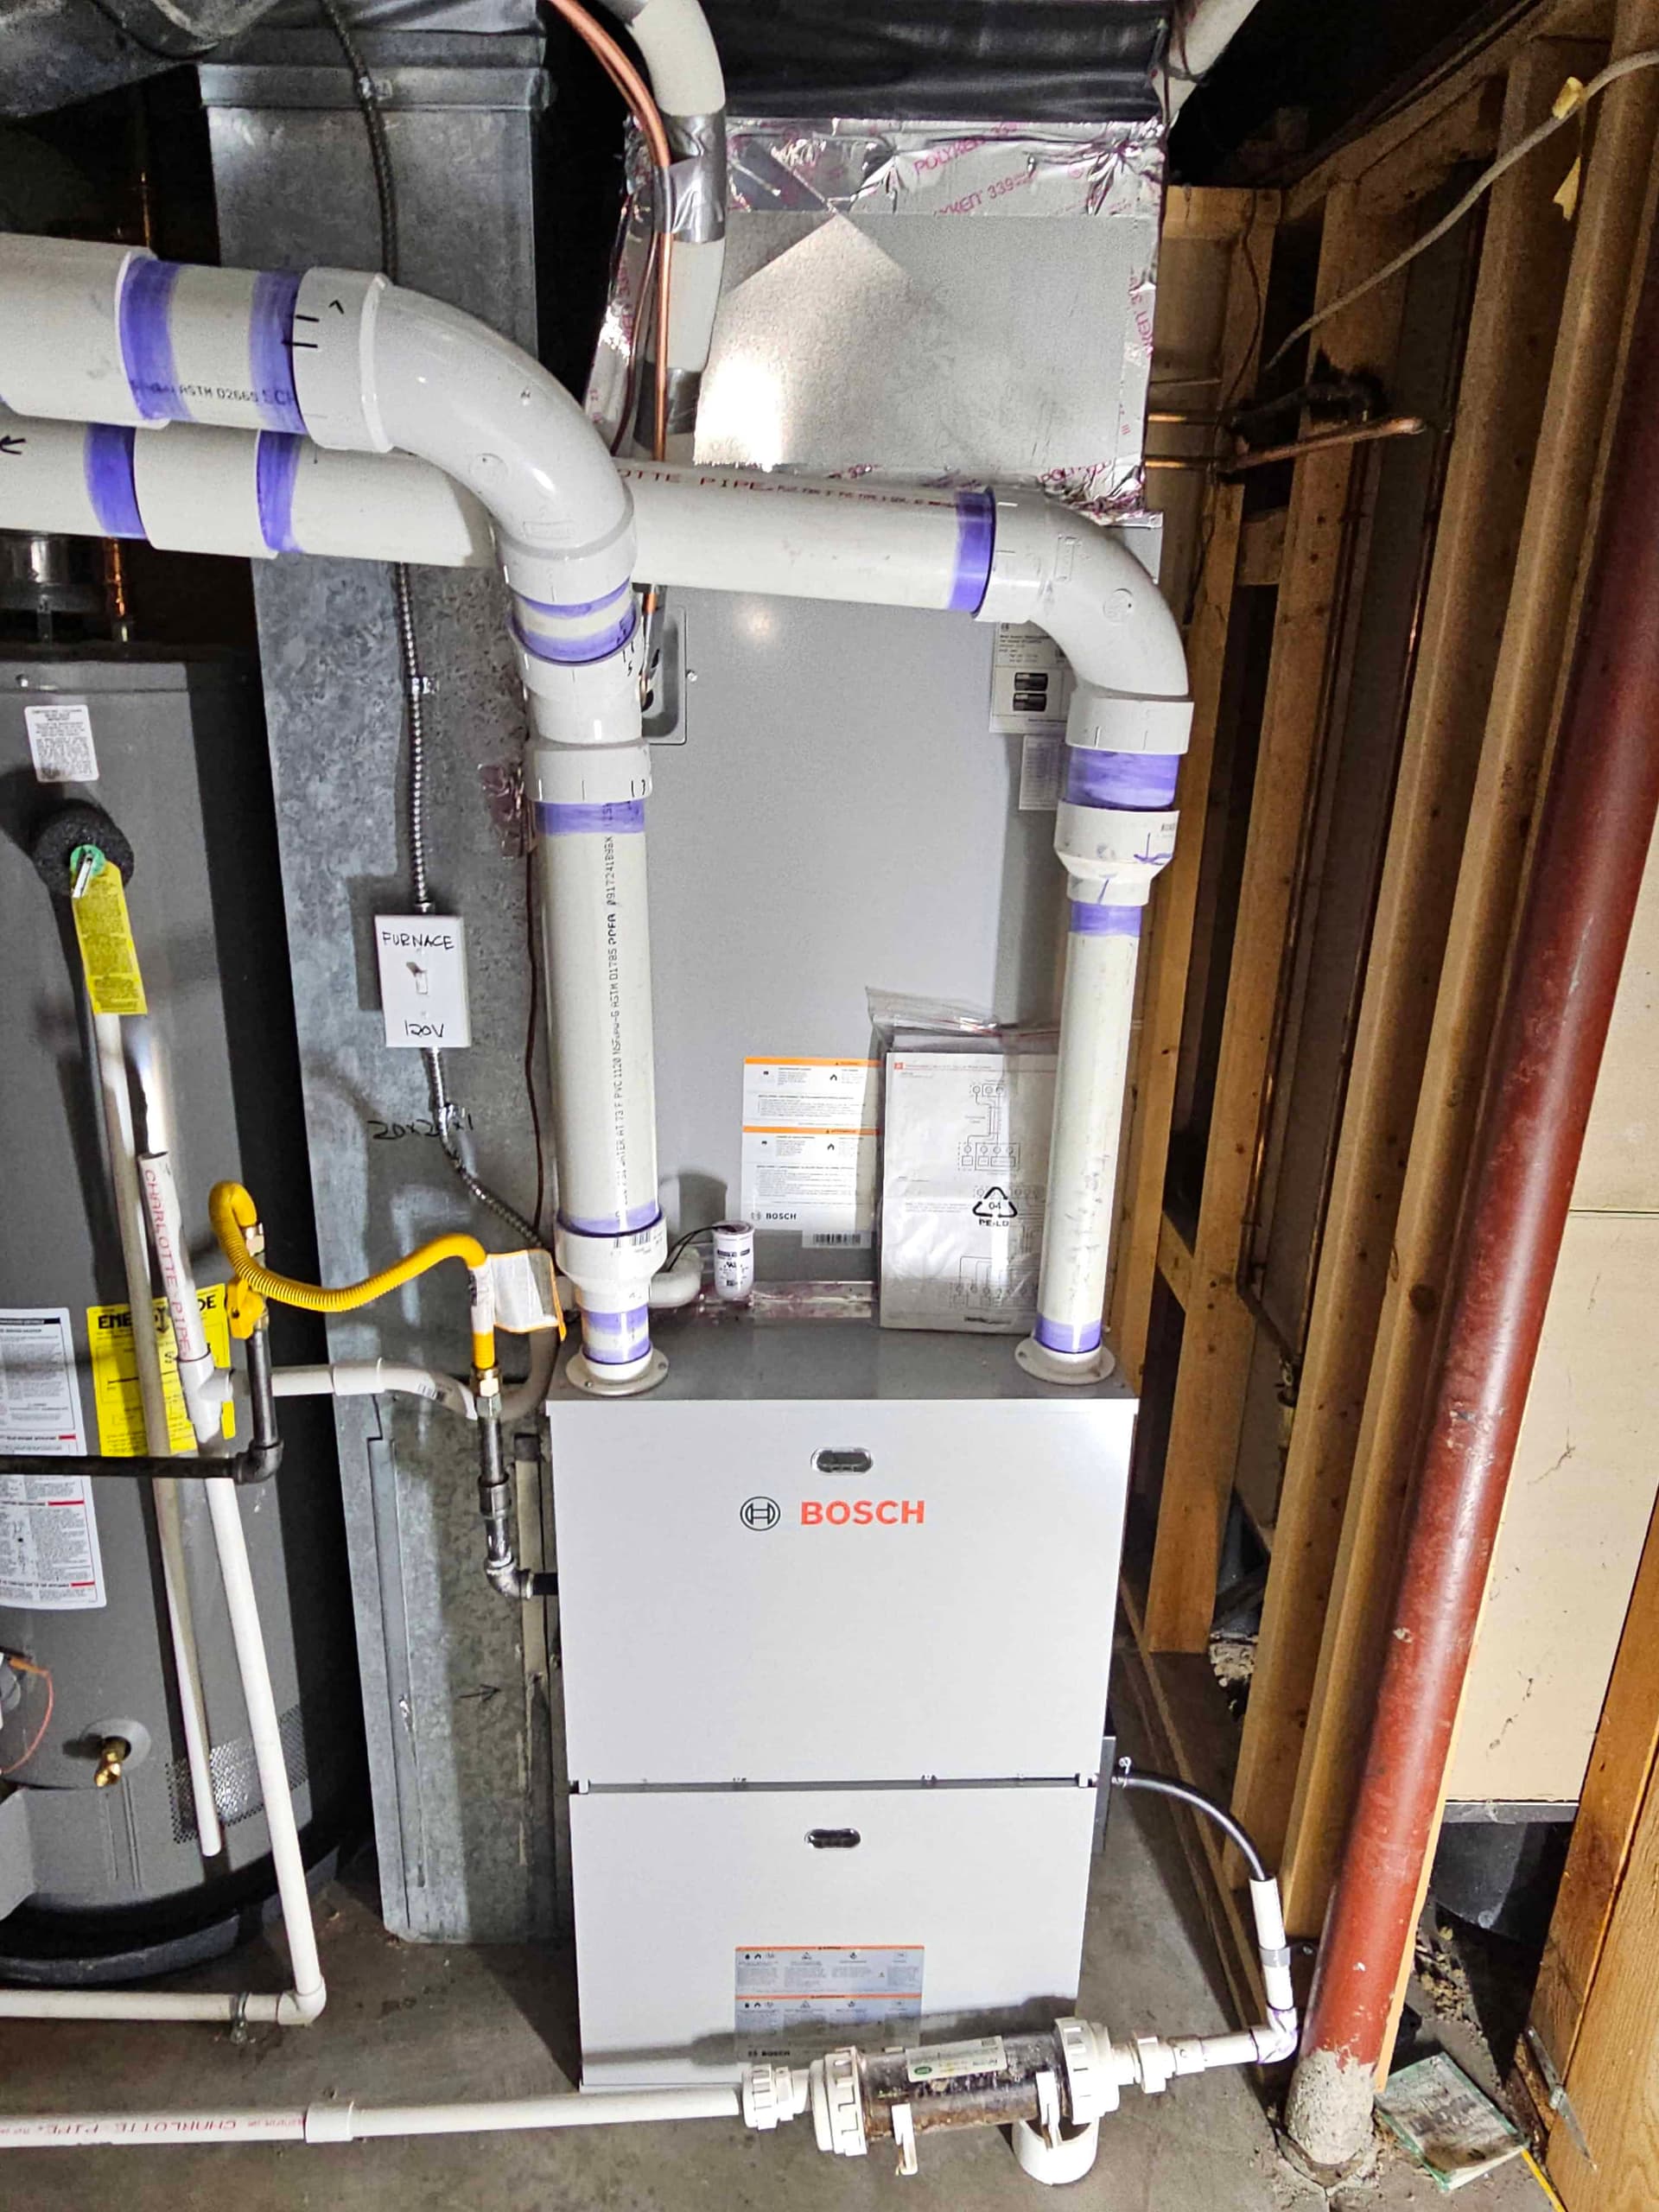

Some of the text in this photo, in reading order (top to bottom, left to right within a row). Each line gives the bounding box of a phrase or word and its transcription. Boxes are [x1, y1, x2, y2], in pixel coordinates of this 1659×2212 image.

[987, 176, 1014, 200] 339
[179, 383, 213, 399] ASTM
[381, 931, 455, 950] FURNACE
[609, 982, 620, 1007] ASTM
[404, 1020, 444, 1038] 120V
[765, 1211, 798, 1220] BOSCH
[144, 1169, 192, 1357] CHARLOTTE PIPE
[801, 1500, 925, 1525] BOSCH
